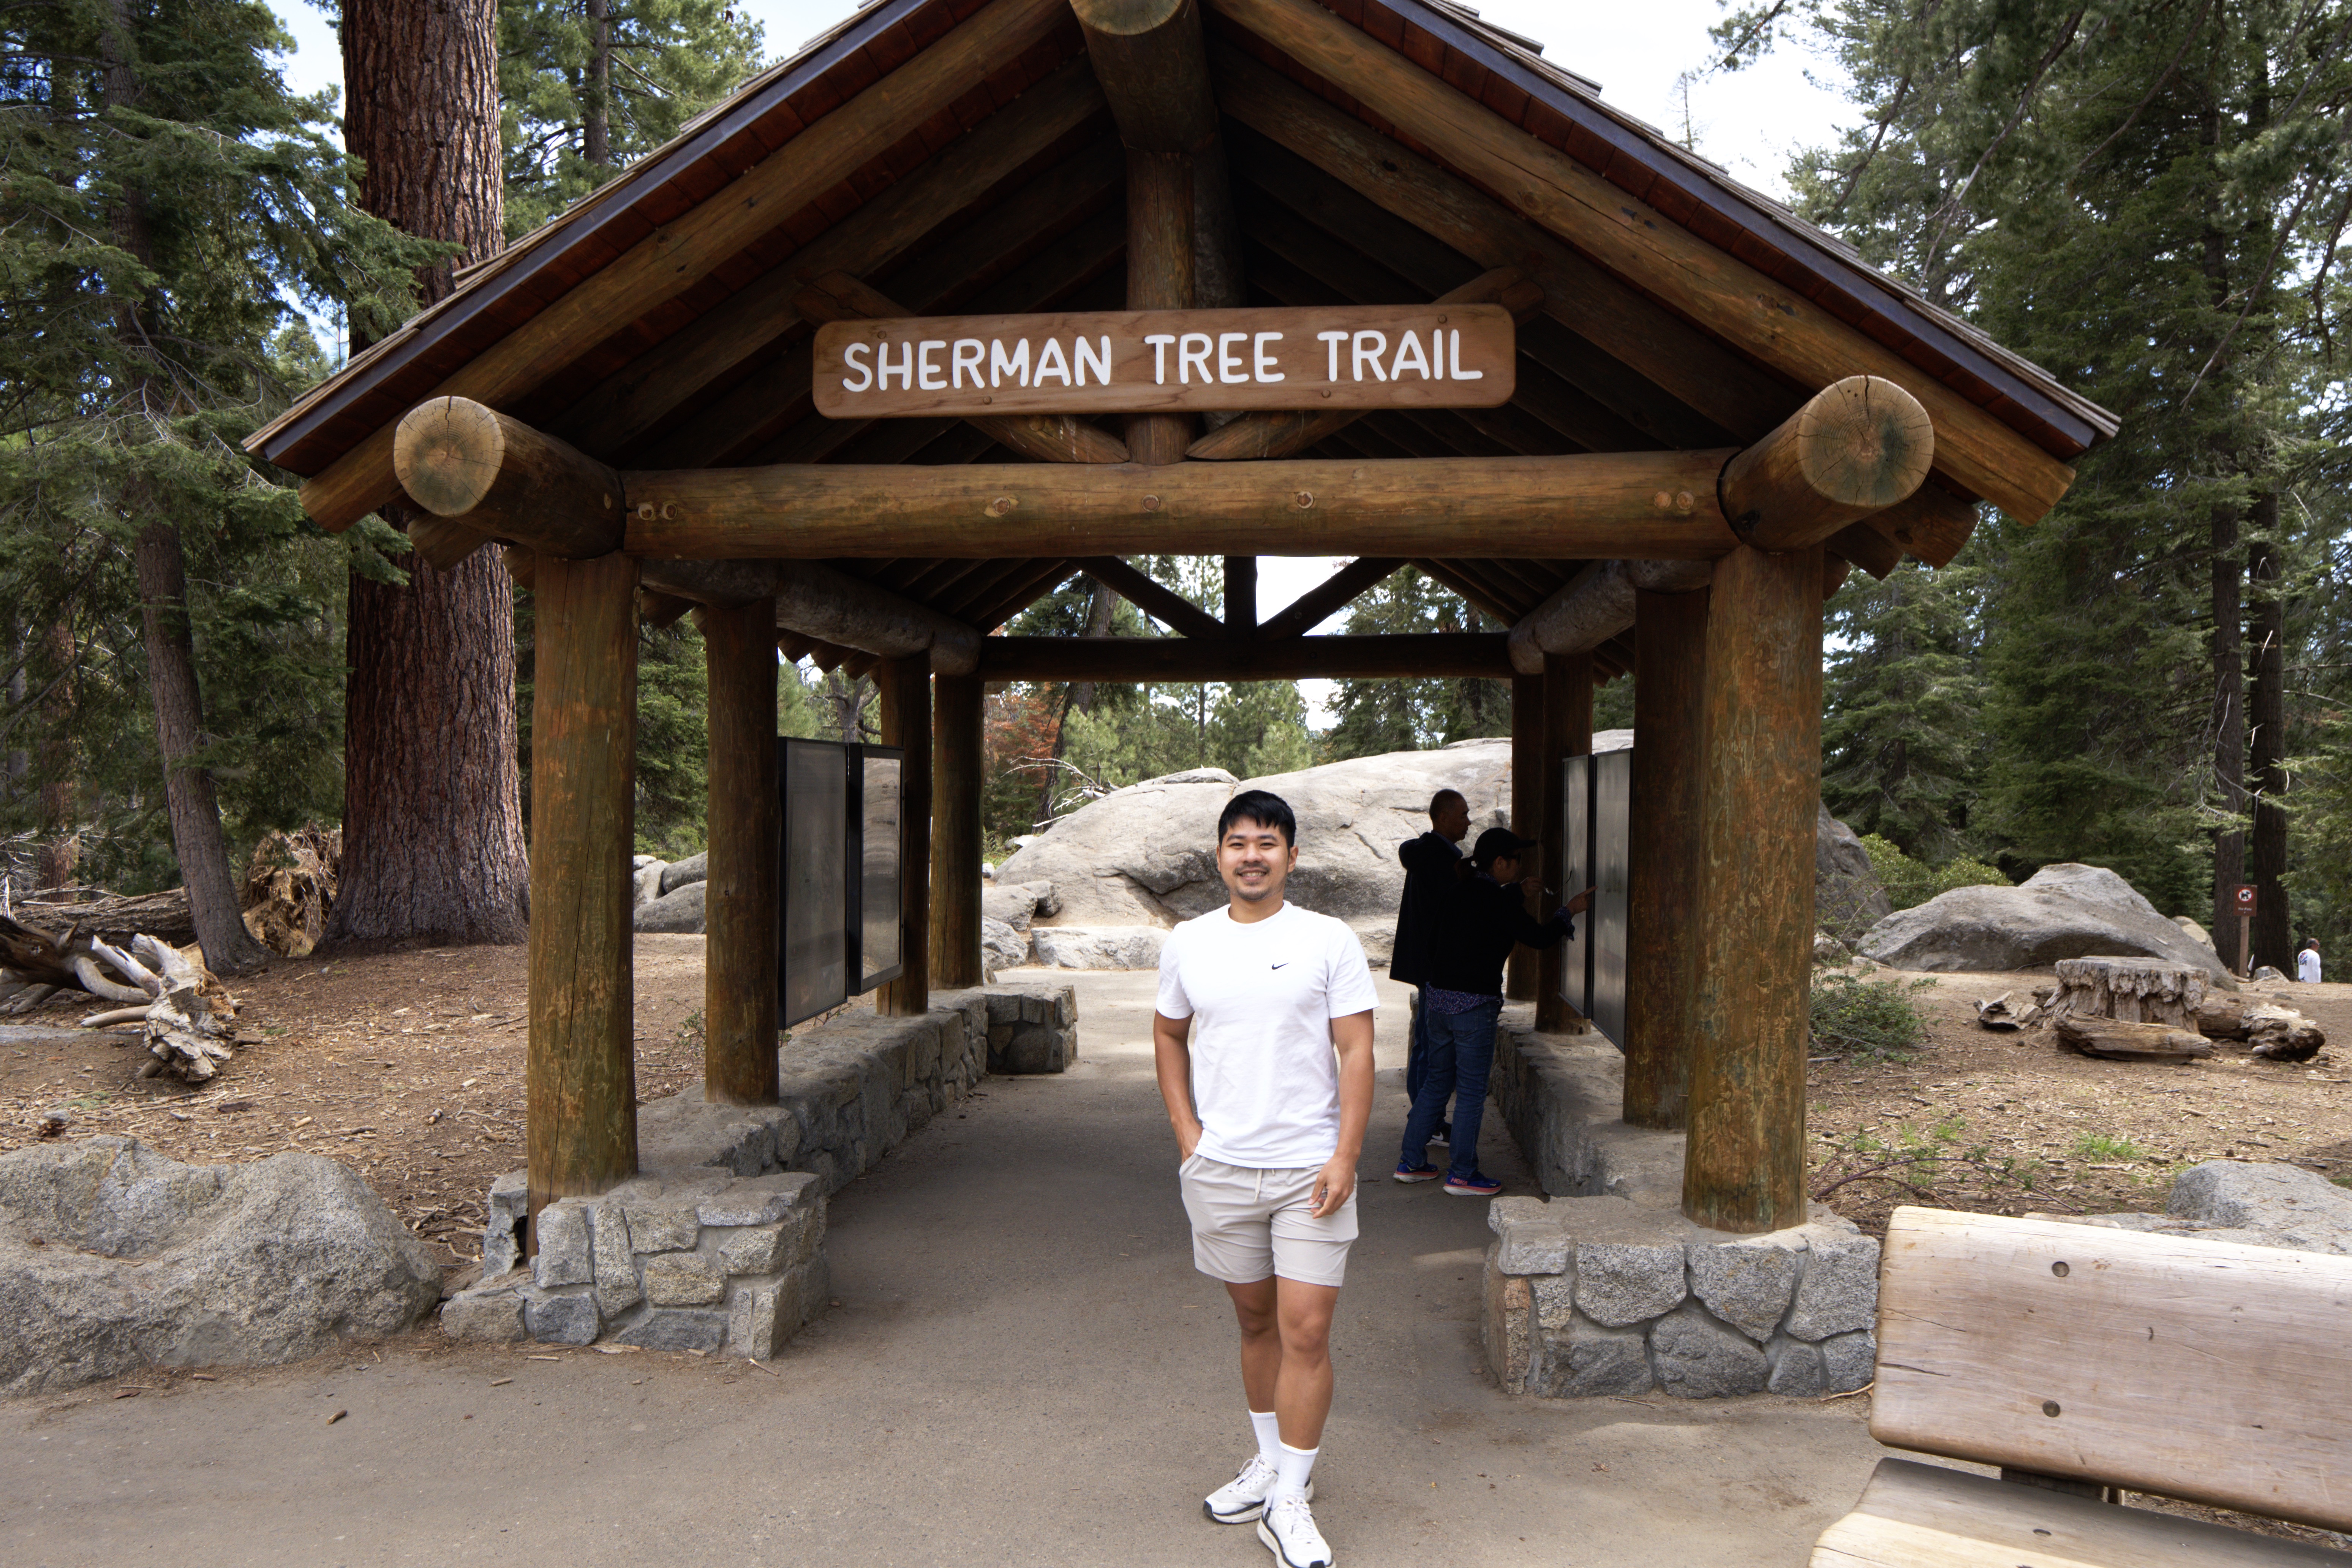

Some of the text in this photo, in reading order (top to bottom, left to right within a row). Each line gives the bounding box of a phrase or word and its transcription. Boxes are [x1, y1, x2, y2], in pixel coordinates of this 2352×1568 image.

[842, 329, 1483, 392] SHERMAN TREE TRAIL
[1451, 1177, 1468, 1185] HOKA
